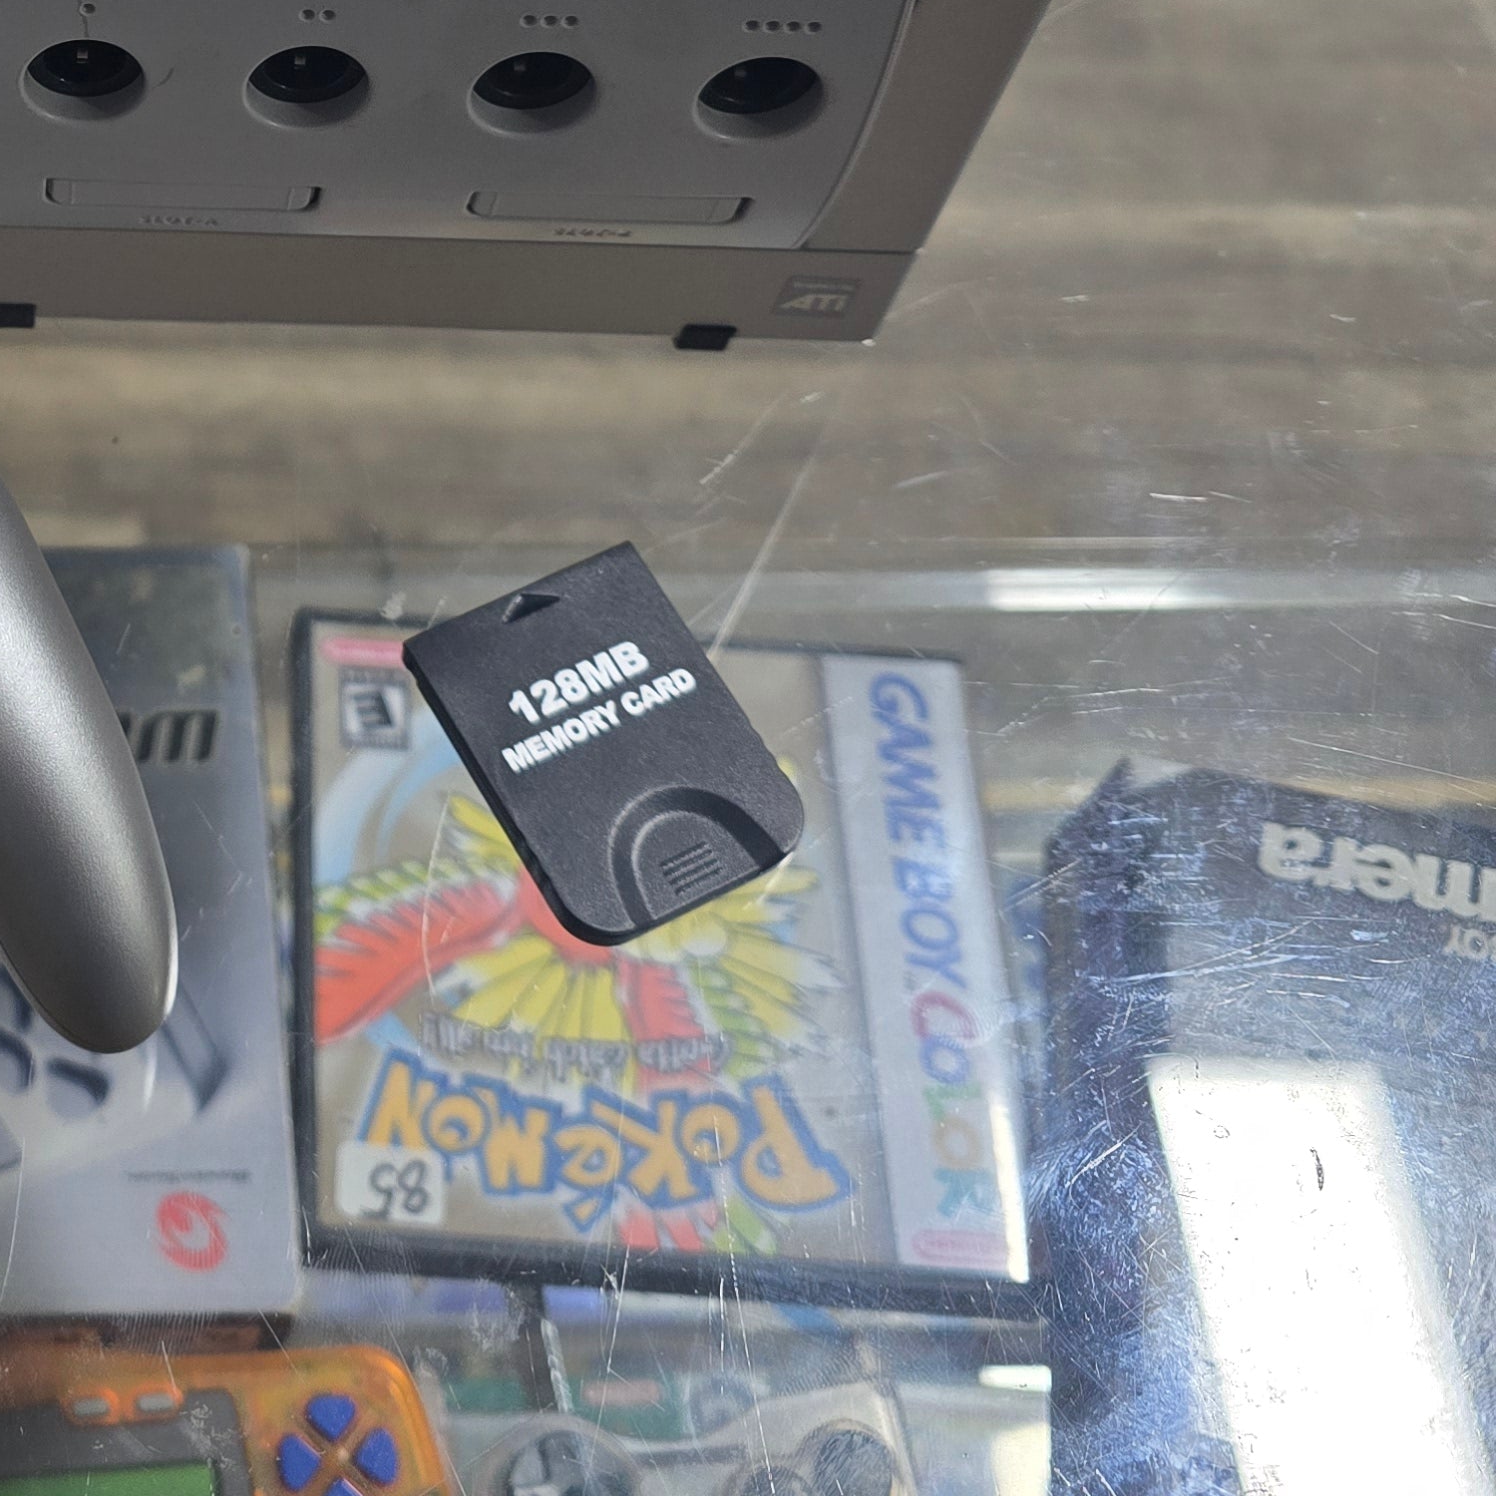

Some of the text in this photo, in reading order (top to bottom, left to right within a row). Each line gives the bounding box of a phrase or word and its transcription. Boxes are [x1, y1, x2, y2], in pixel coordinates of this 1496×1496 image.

[501, 667, 698, 775] MEMORY CARD
[508, 640, 650, 725] 128MB
[868, 672, 945, 848] GAME
[891, 859, 967, 994] BOY
[908, 989, 994, 1220] COLOR
[360, 1159, 429, 1222] 85
